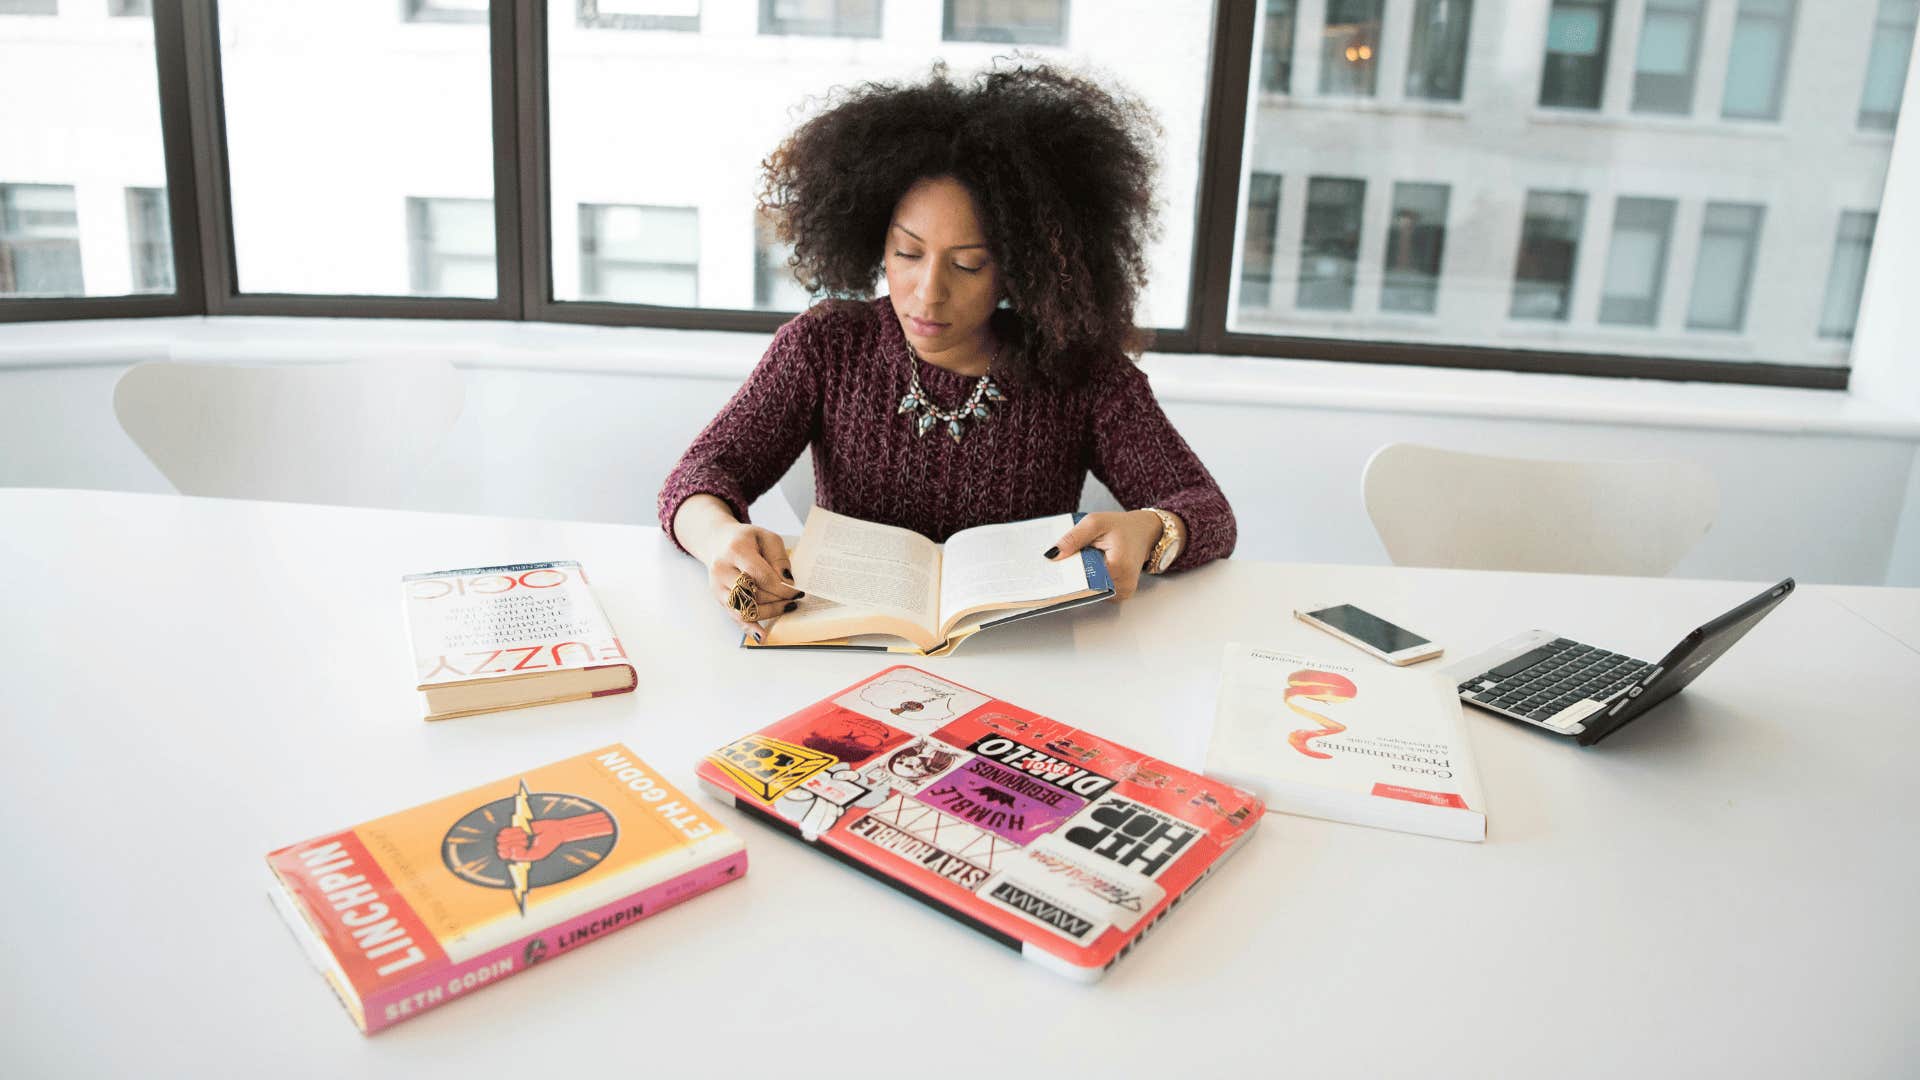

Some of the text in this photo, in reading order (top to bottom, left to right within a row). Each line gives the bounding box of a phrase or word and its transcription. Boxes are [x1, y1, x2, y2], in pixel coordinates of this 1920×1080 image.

[426, 637, 629, 680] FUZZY
[1316, 739, 1451, 768] Programming
[1392, 763, 1453, 779] Cocoa
[597, 752, 713, 839] ETH GODIN
[970, 761, 1065, 806] BEGINNINGS
[930, 786, 1025, 832] HUMBLE
[1091, 806, 1196, 855] HOP
[850, 815, 984, 890] STAY HUMBLE
[1065, 826, 1172, 878] HIP
[300, 841, 427, 977] LINCHPIN
[385, 903, 645, 1021] SETH GODIN LINCHPIN
